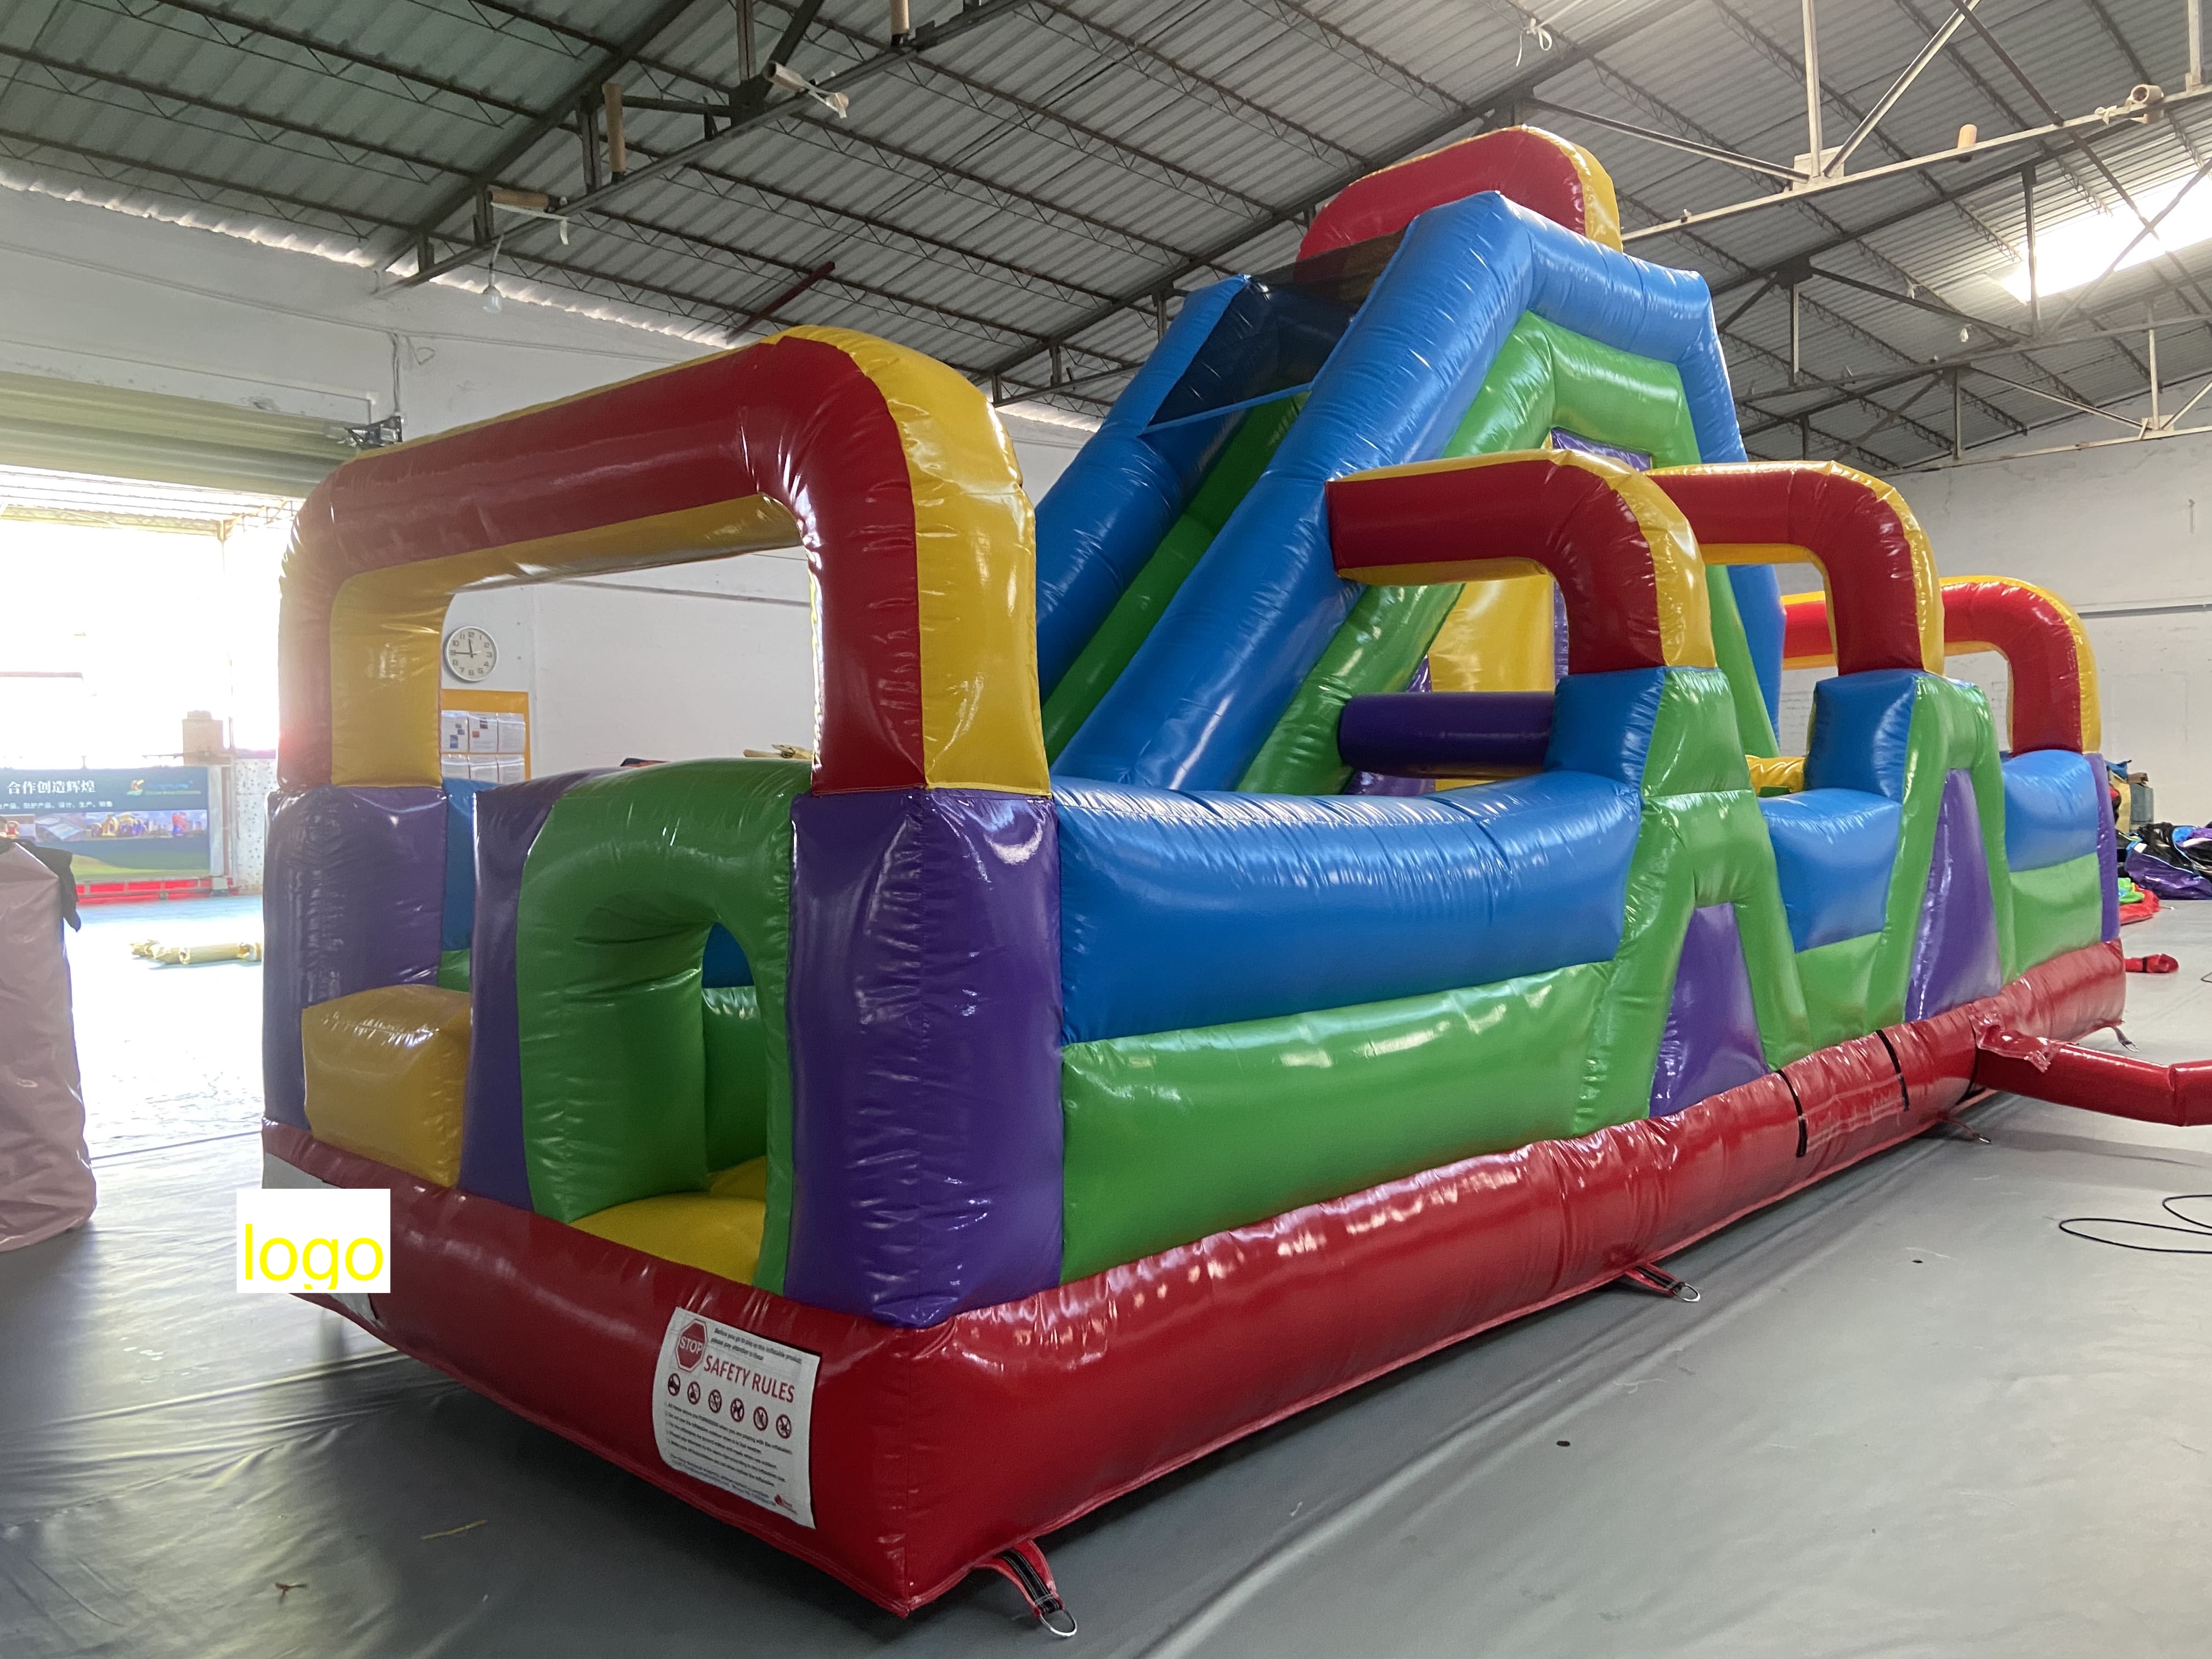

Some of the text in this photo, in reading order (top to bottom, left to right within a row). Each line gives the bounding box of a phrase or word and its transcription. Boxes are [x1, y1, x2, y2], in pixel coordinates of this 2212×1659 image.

[7, 780, 96, 794] 合作创造辉煌
[679, 1336, 703, 1354] STOP
[704, 1355, 795, 1403] SAFETY RULES
